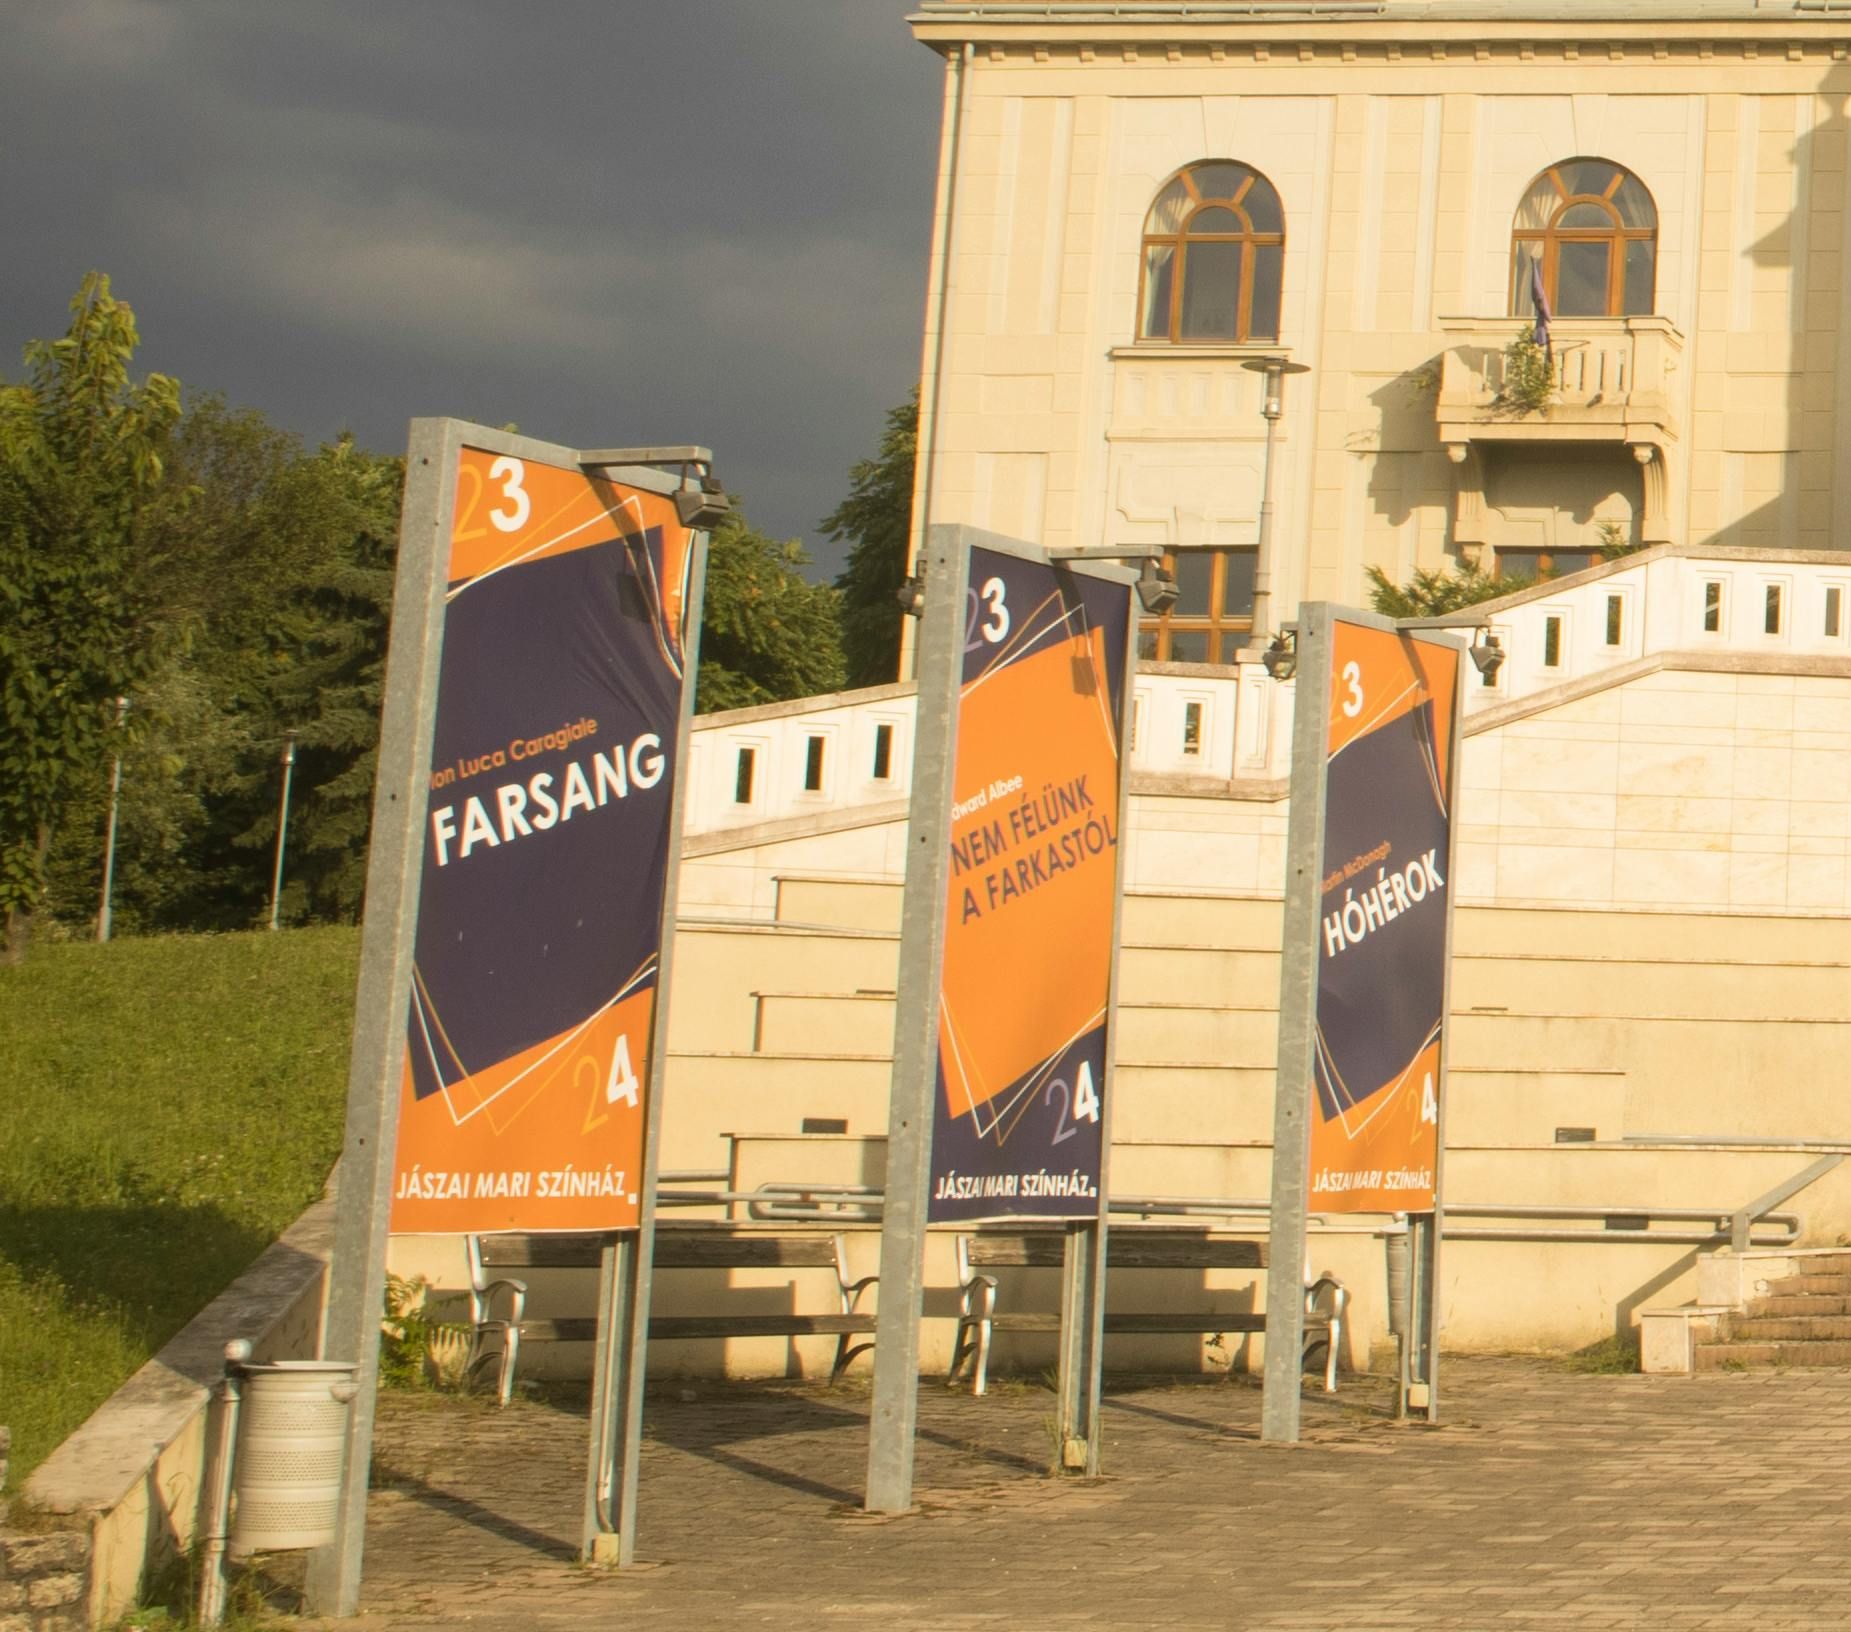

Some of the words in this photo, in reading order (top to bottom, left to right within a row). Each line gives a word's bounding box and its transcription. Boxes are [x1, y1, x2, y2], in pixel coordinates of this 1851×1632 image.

[458, 750, 506, 778] Luca
[510, 717, 598, 760] Caragiale
[431, 732, 666, 867] FARSANG
[951, 787, 987, 821] dward
[989, 775, 1024, 802] Albee
[951, 820, 1007, 877] NEM
[1009, 774, 1094, 845] FÉLÜNK
[962, 887, 982, 925] A
[986, 810, 1118, 910] FARKASTÓL
[1323, 848, 1445, 958] HÓHÉROK
[573, 1034, 639, 1136] 24
[1045, 1060, 1099, 1146] 24
[396, 1164, 470, 1199] JÁSZAI
[474, 1171, 531, 1198] MARI
[935, 1170, 982, 1200] JÁSZAI
[984, 1174, 1018, 1198] MARI
